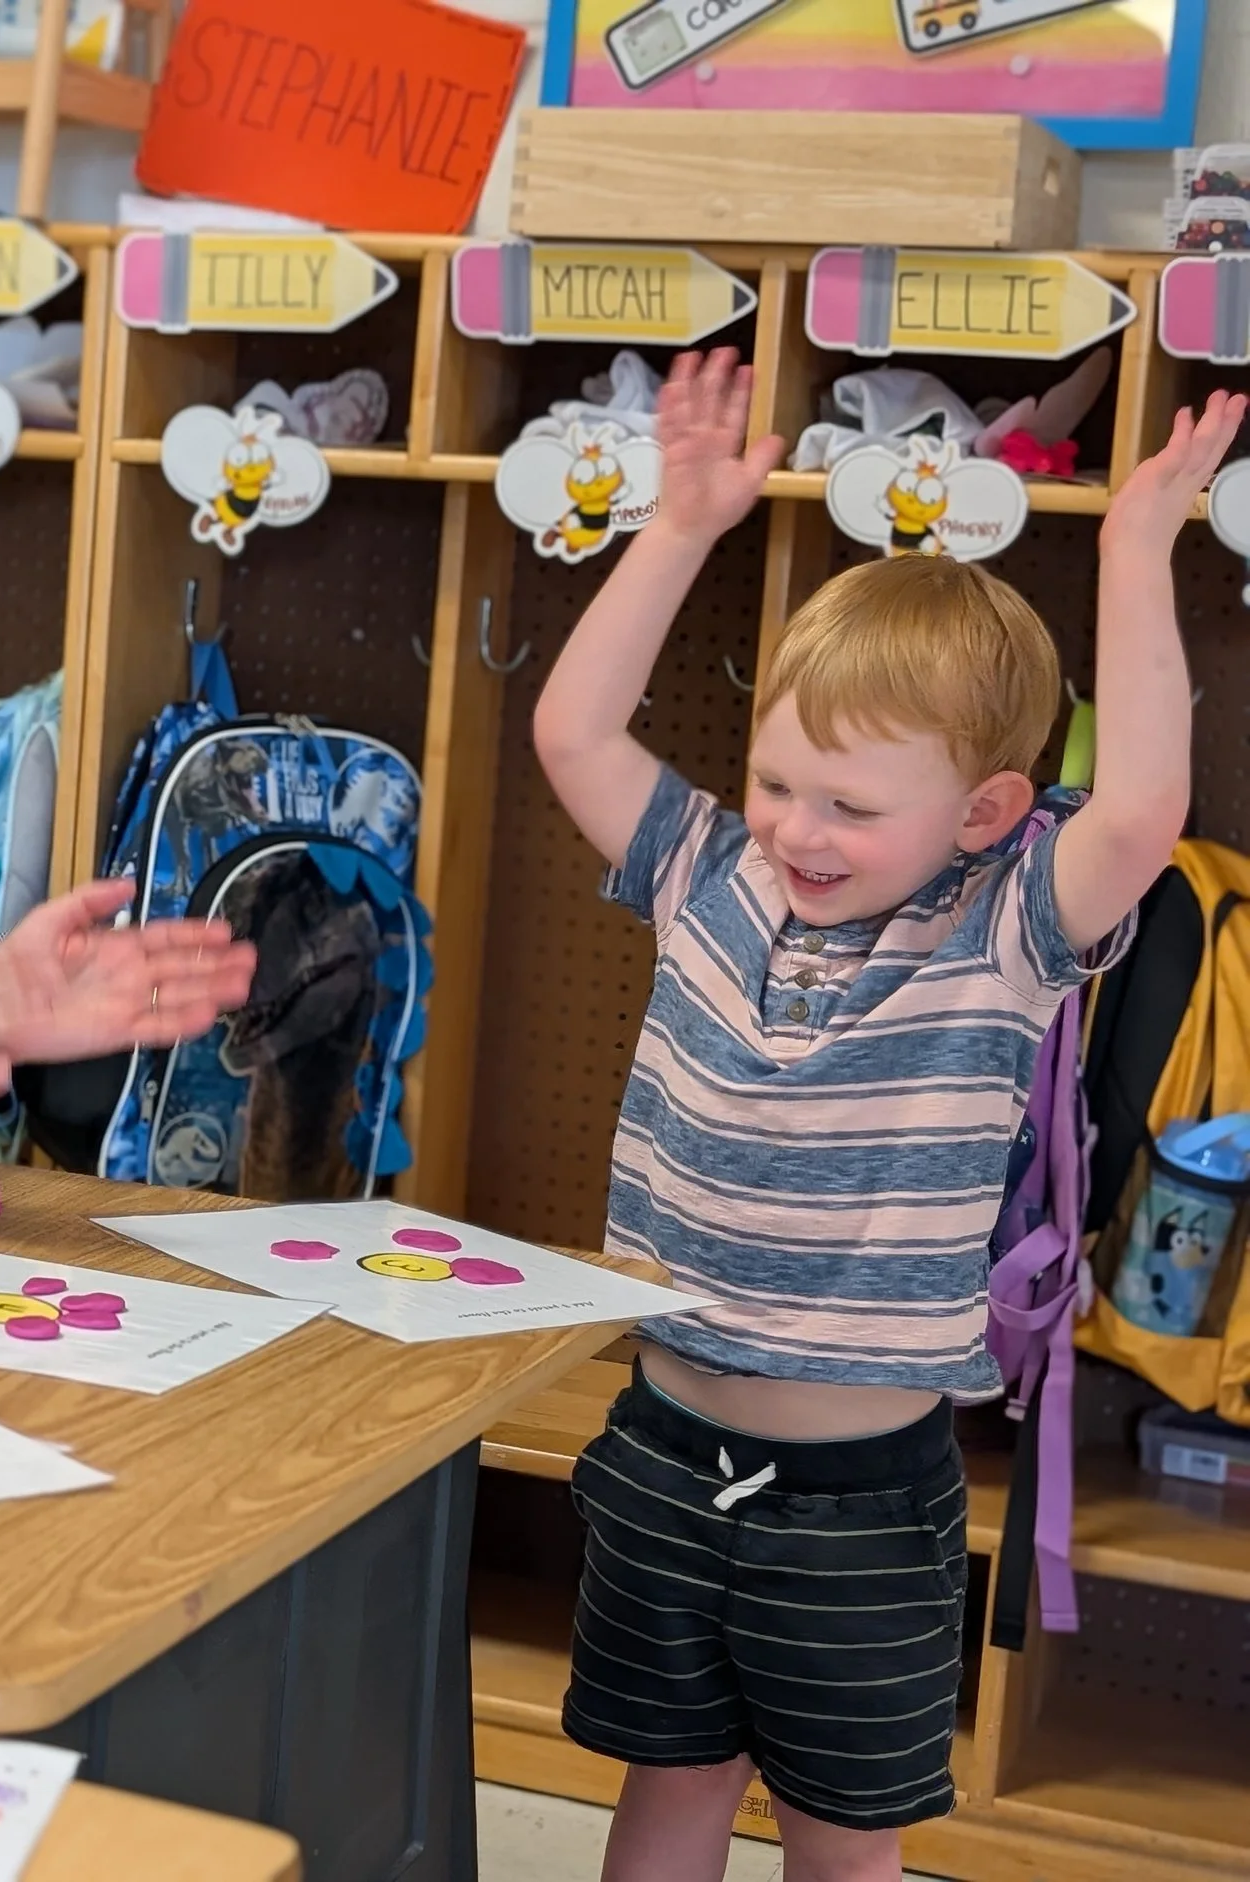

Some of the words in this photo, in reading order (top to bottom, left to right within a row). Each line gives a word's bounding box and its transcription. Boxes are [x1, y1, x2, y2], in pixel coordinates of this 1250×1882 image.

[173, 16, 492, 187] STEPHANIE
[200, 250, 328, 310] TILLY
[542, 263, 667, 322] MICAH
[897, 271, 1053, 335] ELLIE
